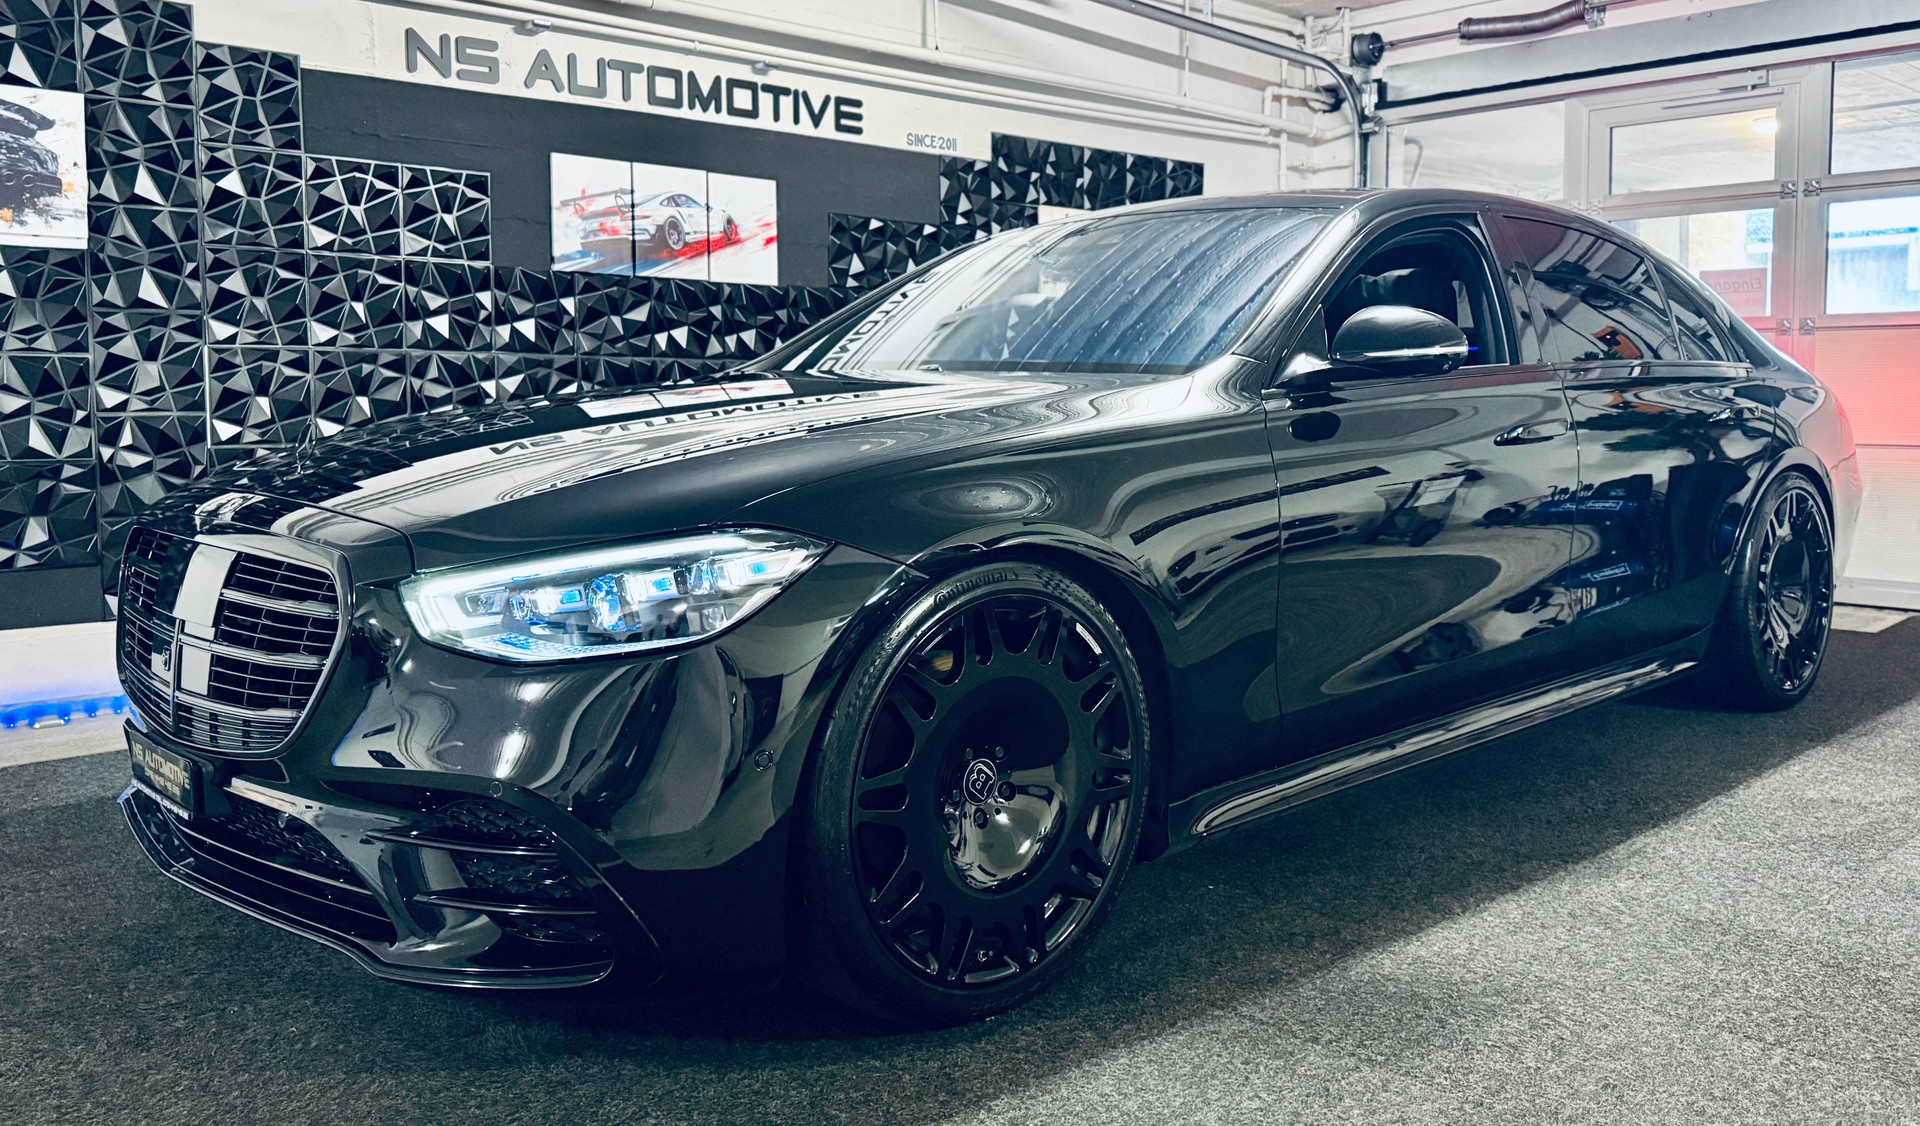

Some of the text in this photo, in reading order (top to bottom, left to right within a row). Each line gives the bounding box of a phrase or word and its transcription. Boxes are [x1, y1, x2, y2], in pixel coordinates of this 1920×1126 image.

[405, 27, 863, 136] NS AUTOMOTIVE
[933, 569, 1008, 610] Continental
[145, 748, 190, 789] AUTOMOTIVE
